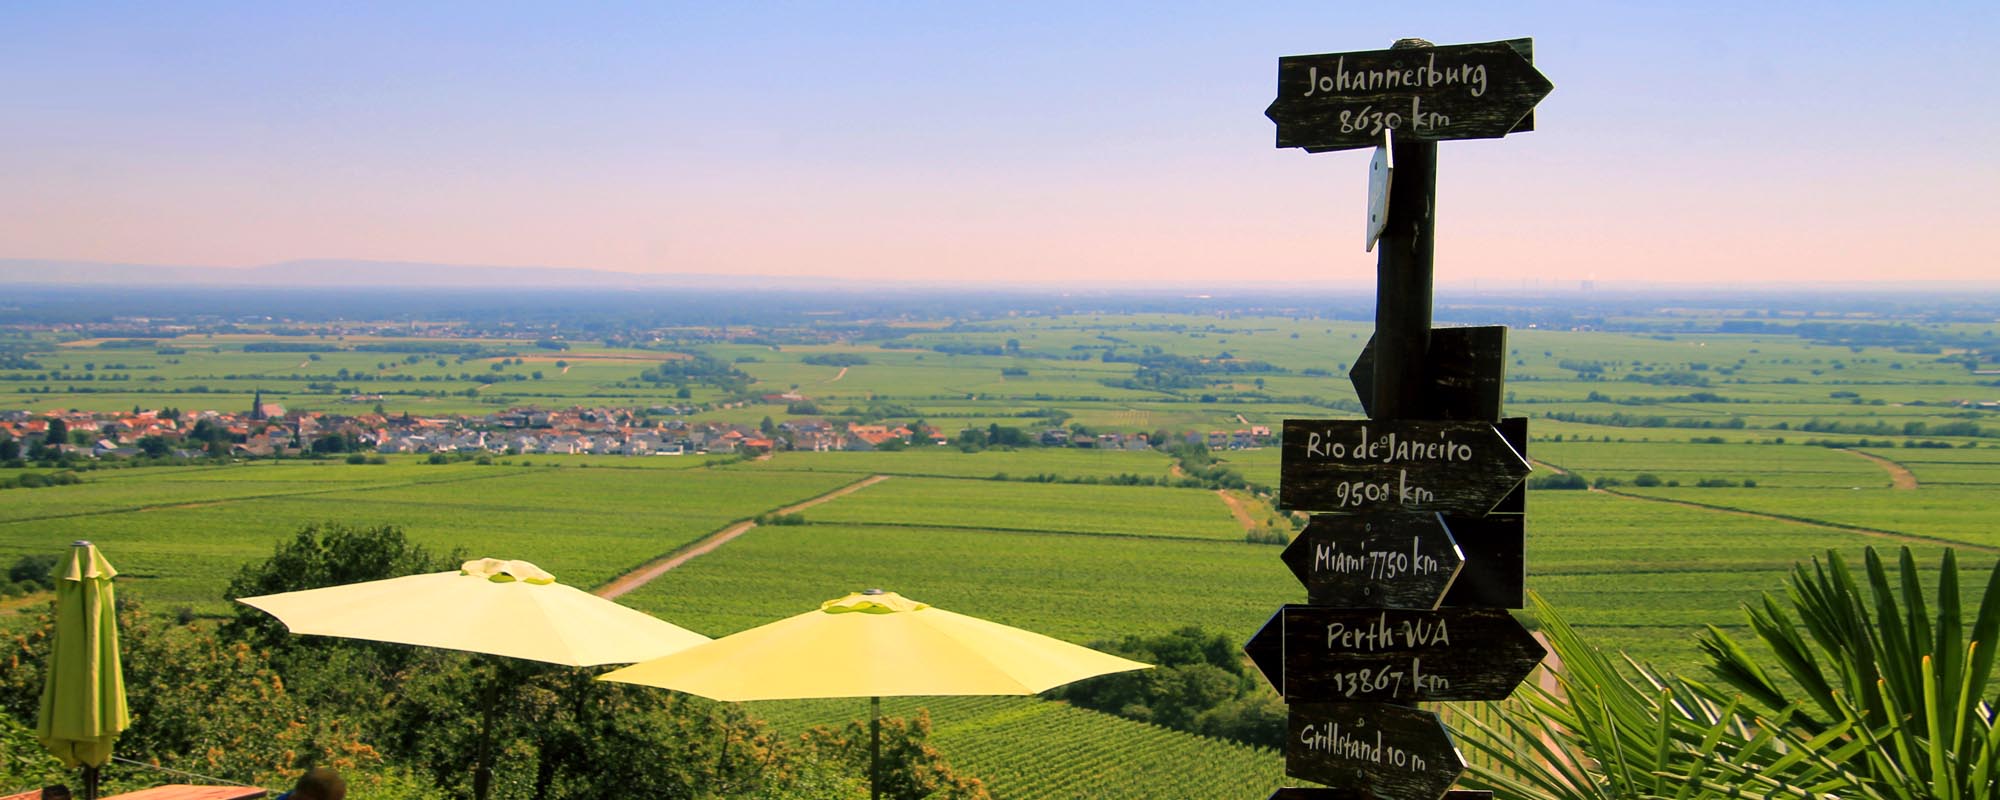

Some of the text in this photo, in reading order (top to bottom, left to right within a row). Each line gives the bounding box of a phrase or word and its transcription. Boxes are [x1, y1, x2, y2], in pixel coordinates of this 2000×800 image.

[1304, 52, 1487, 97] Johannesburg
[1339, 96, 1450, 135] 8630 km
[1307, 425, 1472, 463] Rio de Janeiro
[1400, 469, 1433, 504] km
[1315, 535, 1437, 580] Miami 7750 km
[1333, 657, 1449, 698] 13867 km
[1300, 721, 1426, 772] Grillstand 10 m
